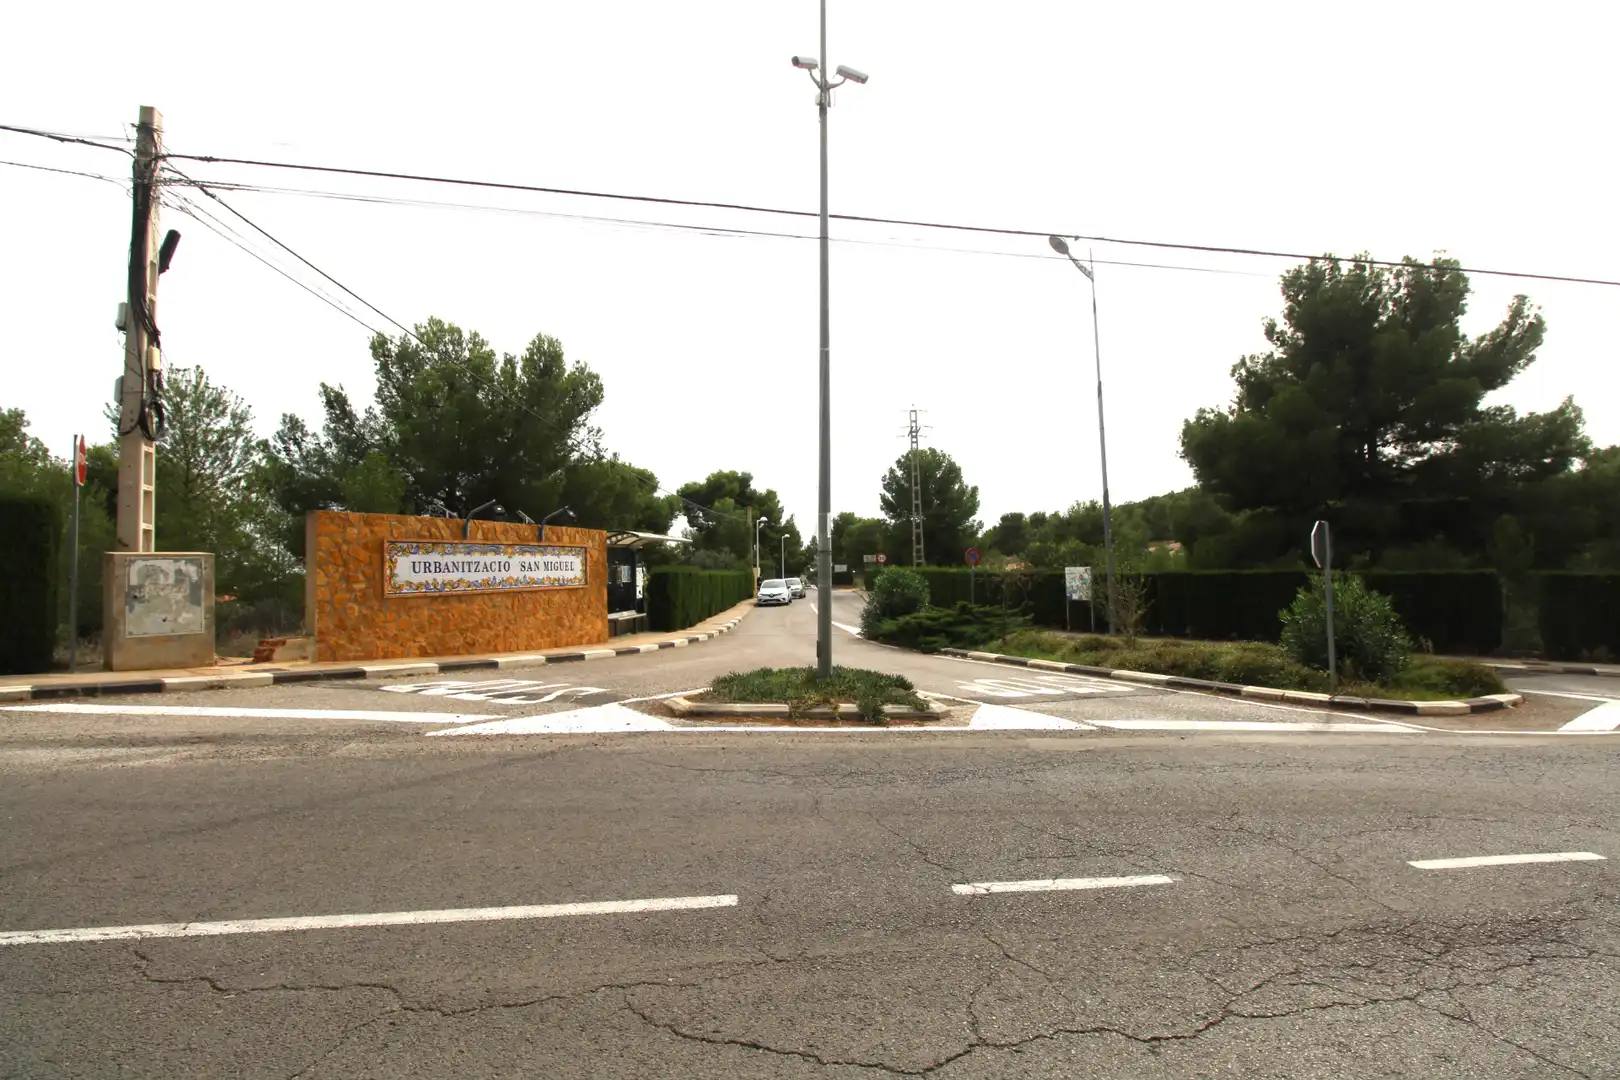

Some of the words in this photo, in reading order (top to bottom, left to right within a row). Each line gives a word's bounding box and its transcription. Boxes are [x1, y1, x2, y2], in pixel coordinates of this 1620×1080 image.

[411, 560, 511, 574] URBANITZACIO
[520, 560, 540, 572] SAN
[543, 560, 575, 572] MIGUEL
